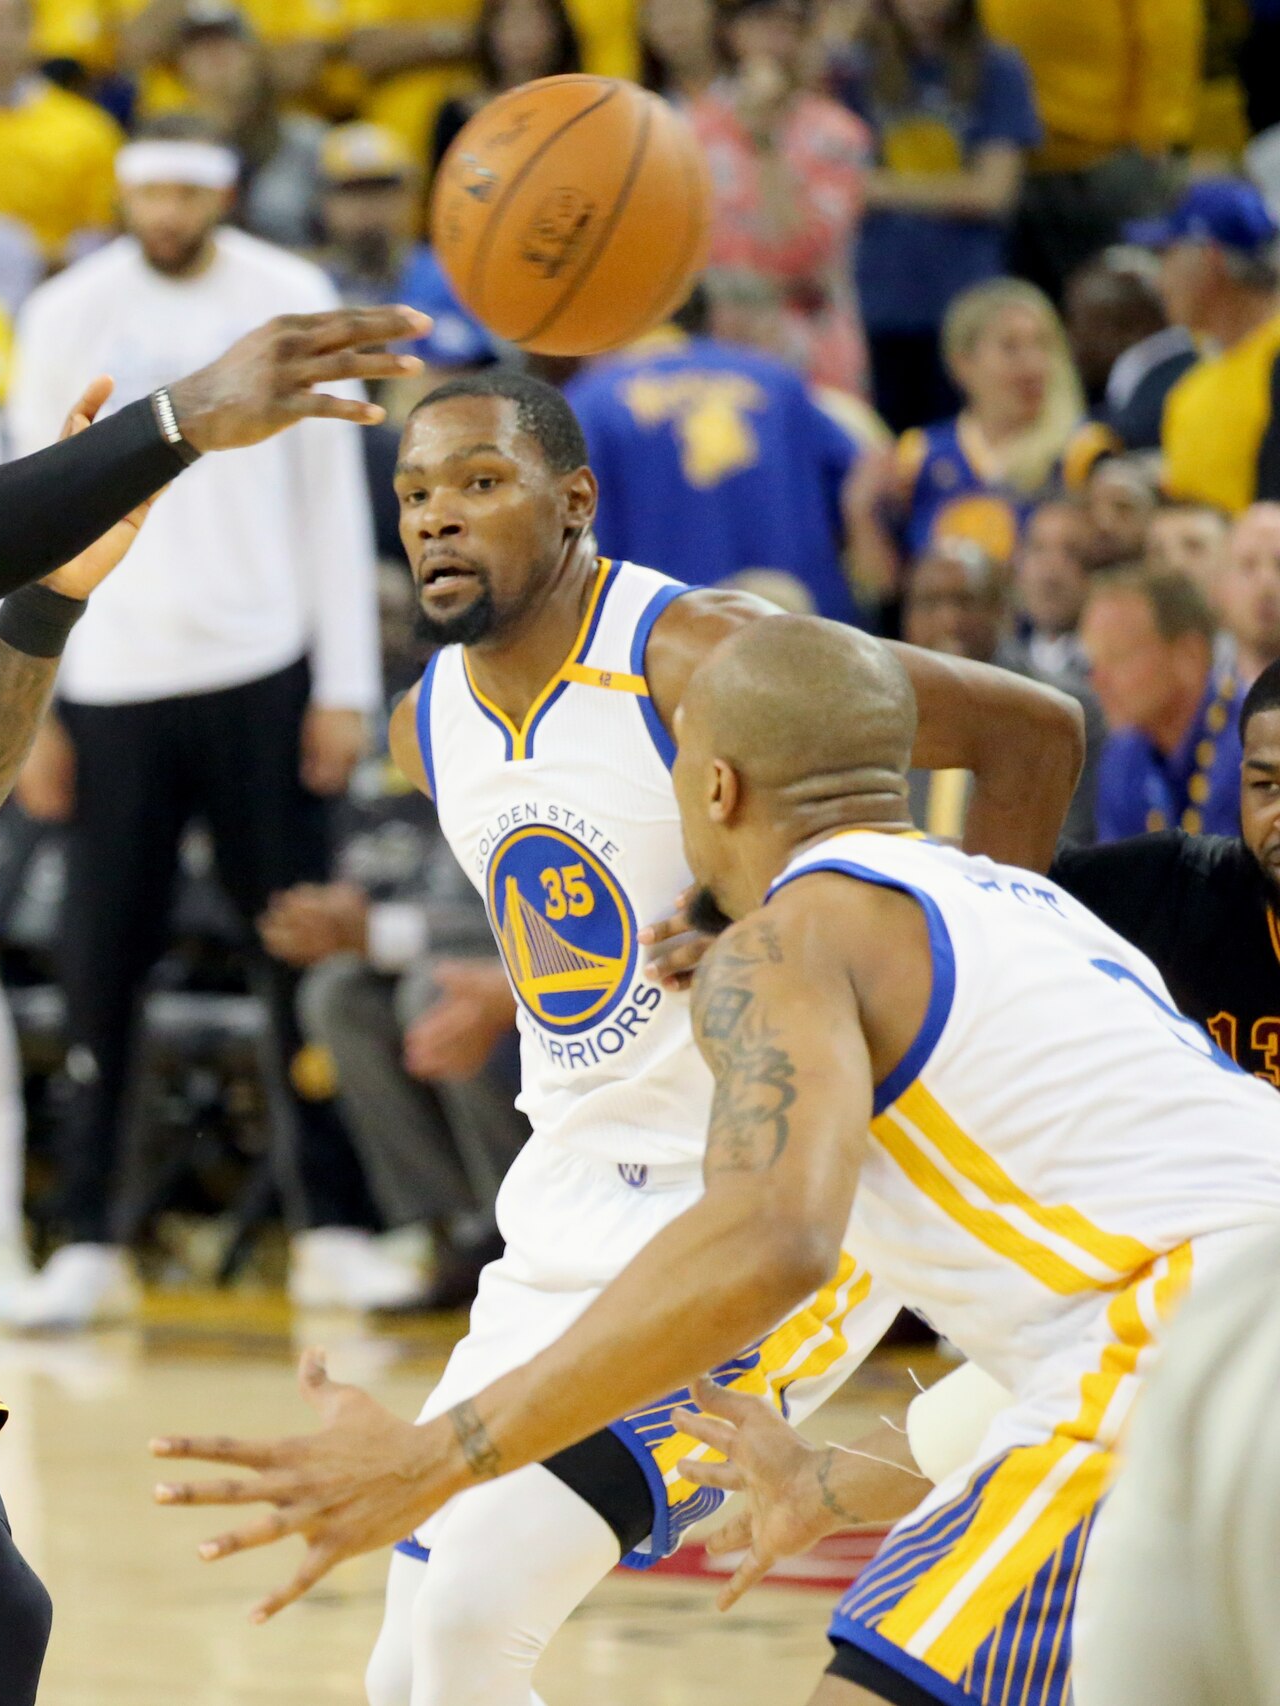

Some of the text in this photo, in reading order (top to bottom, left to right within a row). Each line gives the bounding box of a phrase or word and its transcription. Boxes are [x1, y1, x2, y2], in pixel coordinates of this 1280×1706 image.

[547, 805, 620, 862] STATE
[539, 862, 595, 920] 35
[523, 983, 662, 1070] RRIORS
